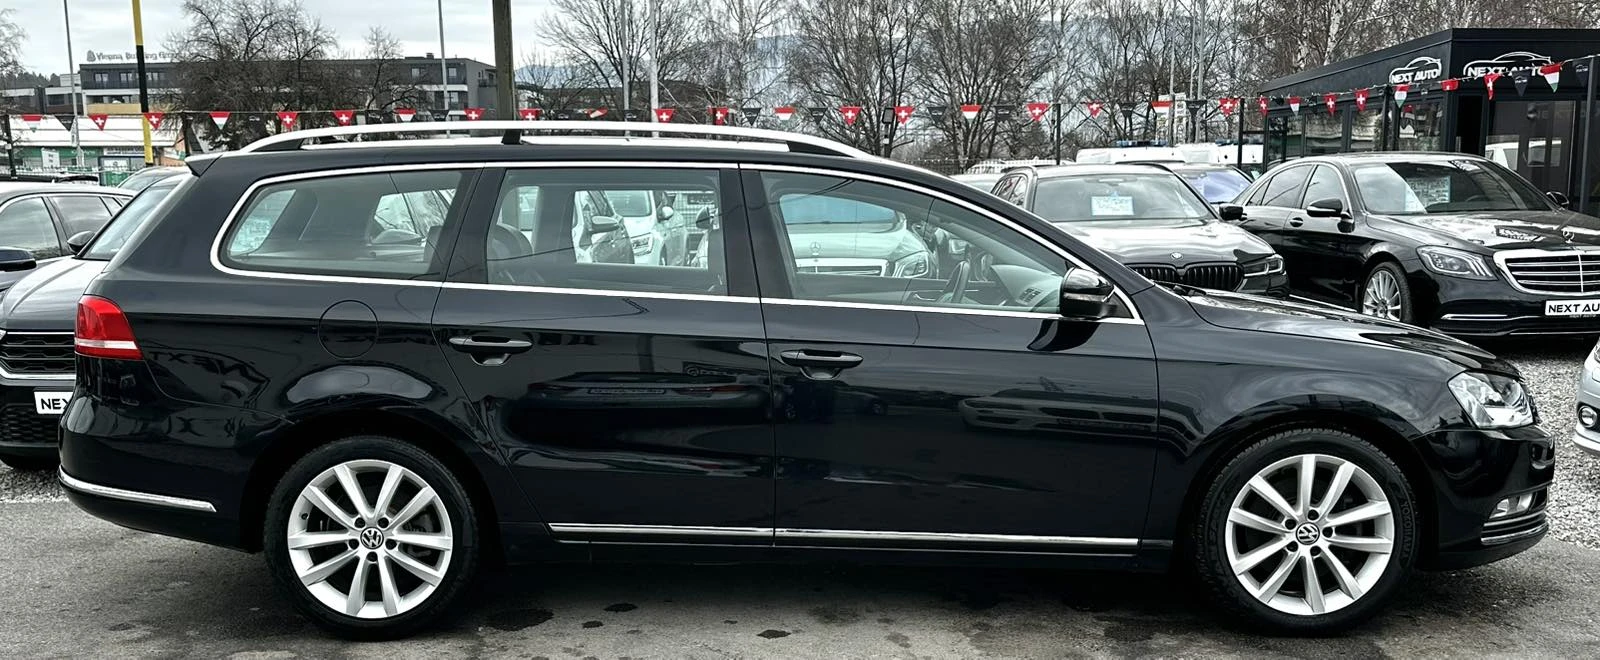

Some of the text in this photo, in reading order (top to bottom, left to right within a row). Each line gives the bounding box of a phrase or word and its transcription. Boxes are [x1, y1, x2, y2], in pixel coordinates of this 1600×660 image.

[126, 52, 158, 60] Buing
[1468, 66, 1506, 76] NEXT
[1392, 69, 1438, 83] NEXT AUTO
[1548, 304, 1580, 313] NEXT
